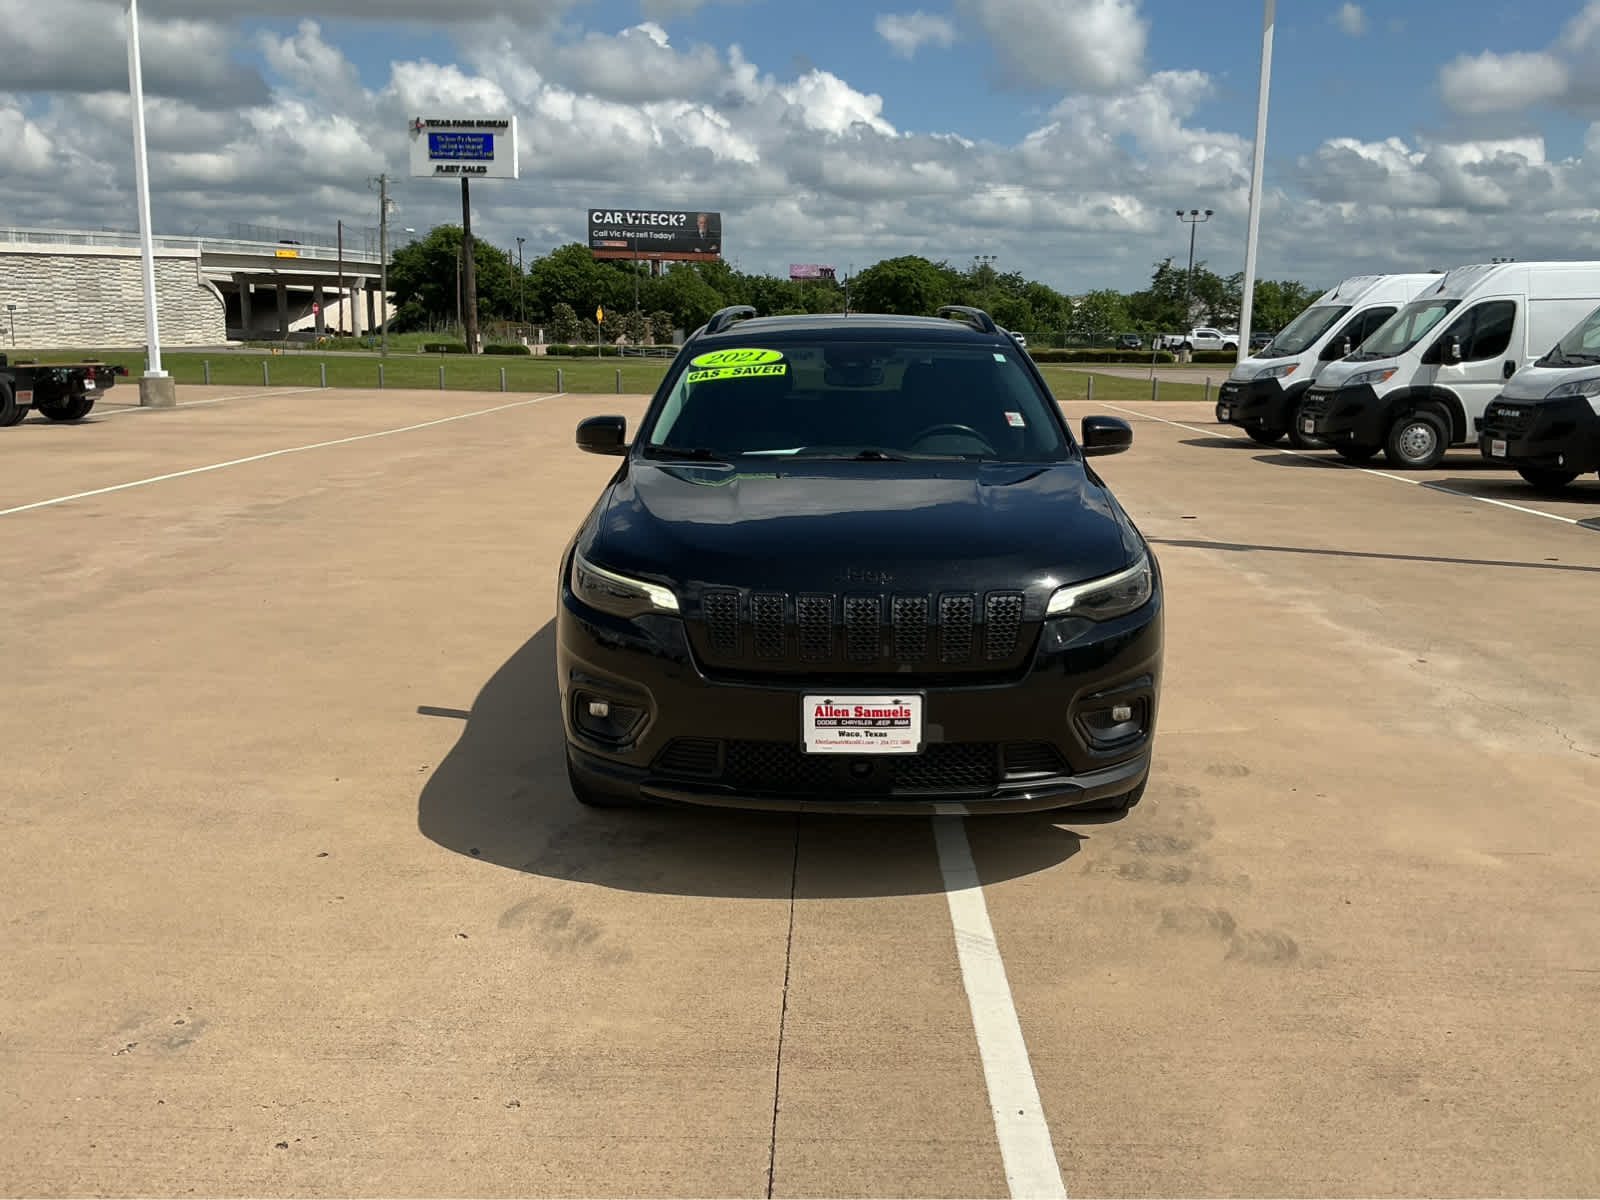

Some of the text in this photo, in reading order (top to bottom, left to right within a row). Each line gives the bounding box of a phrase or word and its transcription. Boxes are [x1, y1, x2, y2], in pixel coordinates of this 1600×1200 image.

[425, 120, 508, 128] TEXAS FARM BUREAU
[436, 165, 487, 174] FLEET SALES
[592, 211, 622, 224] CAR
[592, 230, 608, 238] Call
[610, 230, 621, 238] Vic
[650, 231, 675, 240] Today!
[706, 351, 767, 365] 2021
[689, 369, 720, 381] GAS
[732, 366, 783, 376] SAVER
[814, 705, 911, 718] Allen Samuels
[838, 730, 888, 738] Waco, Texas
